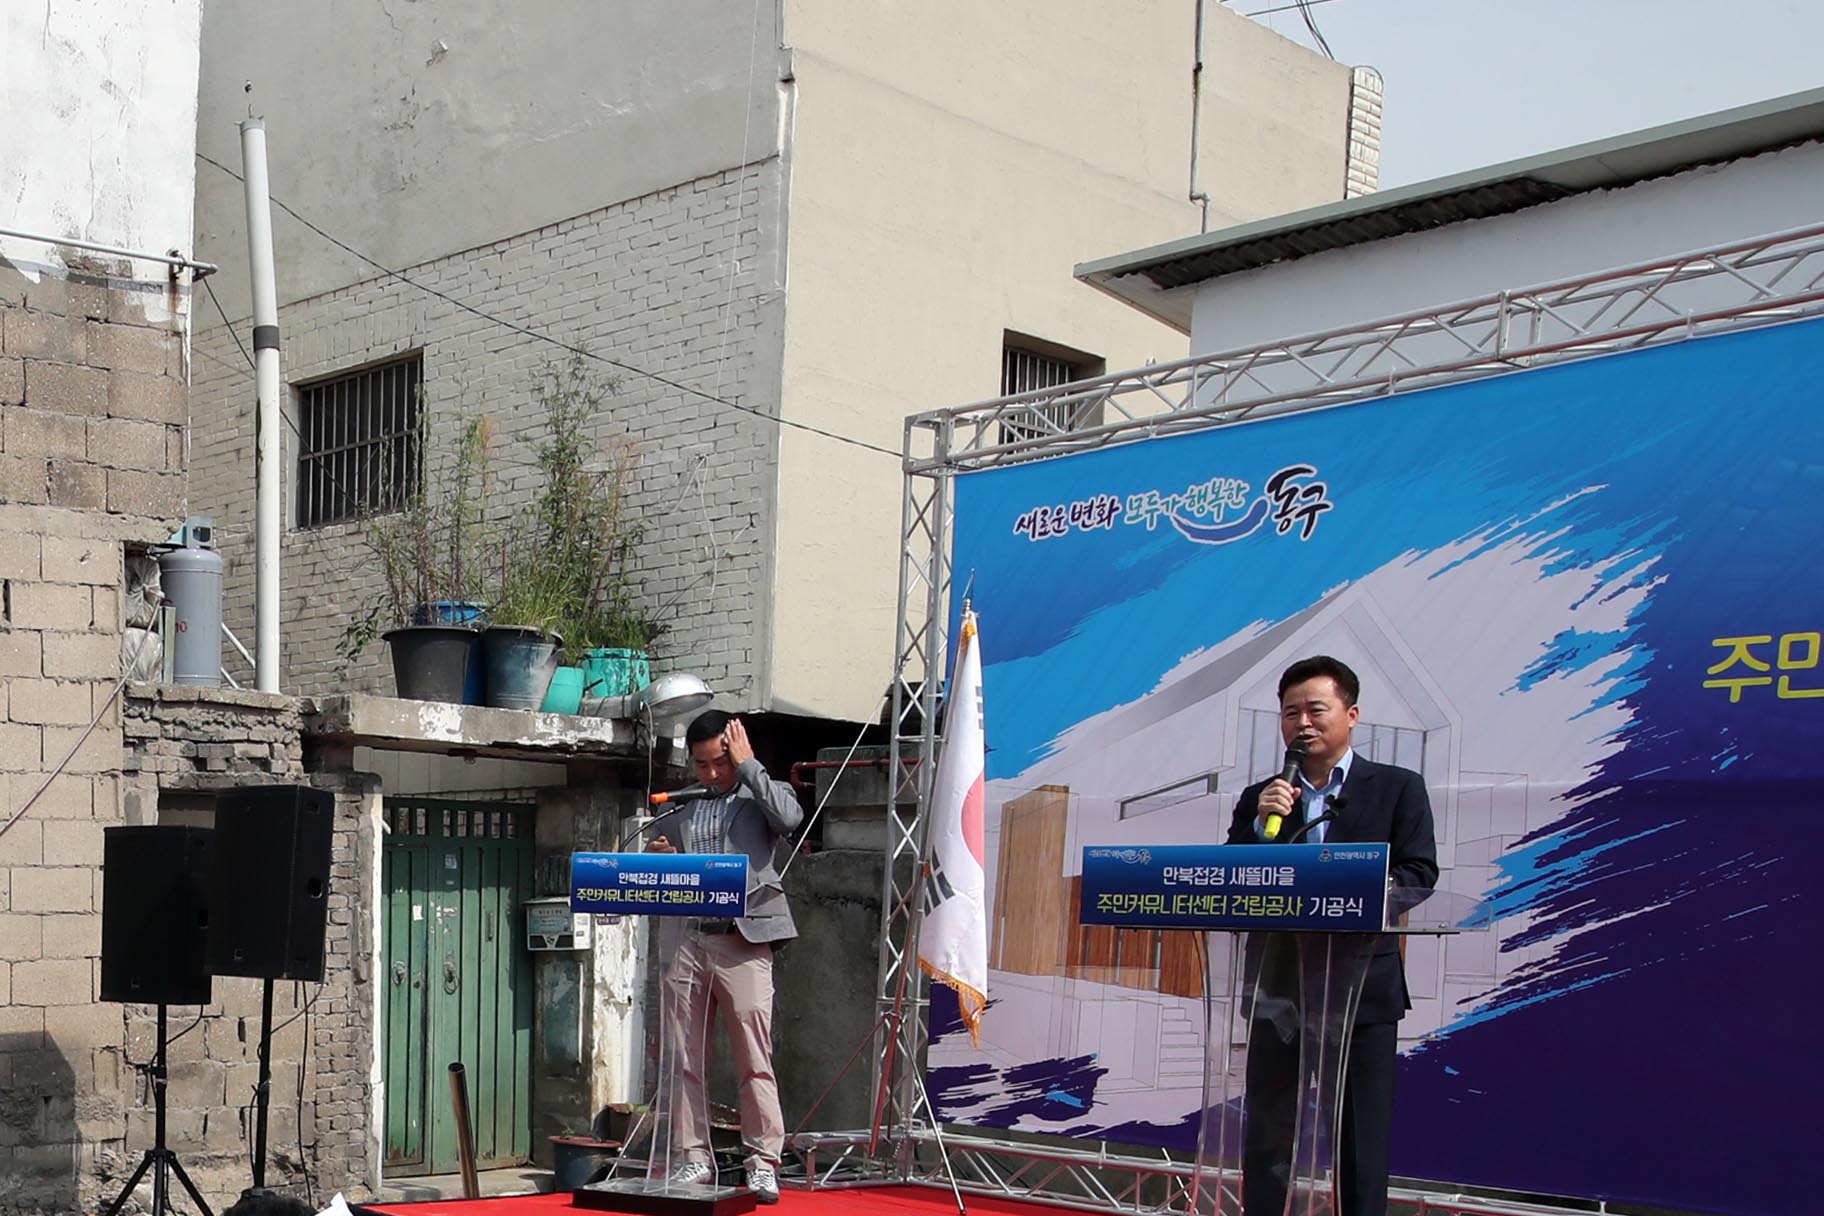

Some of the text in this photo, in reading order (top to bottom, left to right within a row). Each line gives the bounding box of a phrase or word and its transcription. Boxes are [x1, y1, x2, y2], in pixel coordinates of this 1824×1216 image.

[1015, 466, 1331, 540] 새로운 변화 모두가 행복한 동구
[1163, 865, 1295, 887] 만북접경 새뜰마을
[708, 891, 739, 905] 기공식
[1231, 895, 1303, 917] 건립공사
[1309, 896, 1363, 918] 기공식
